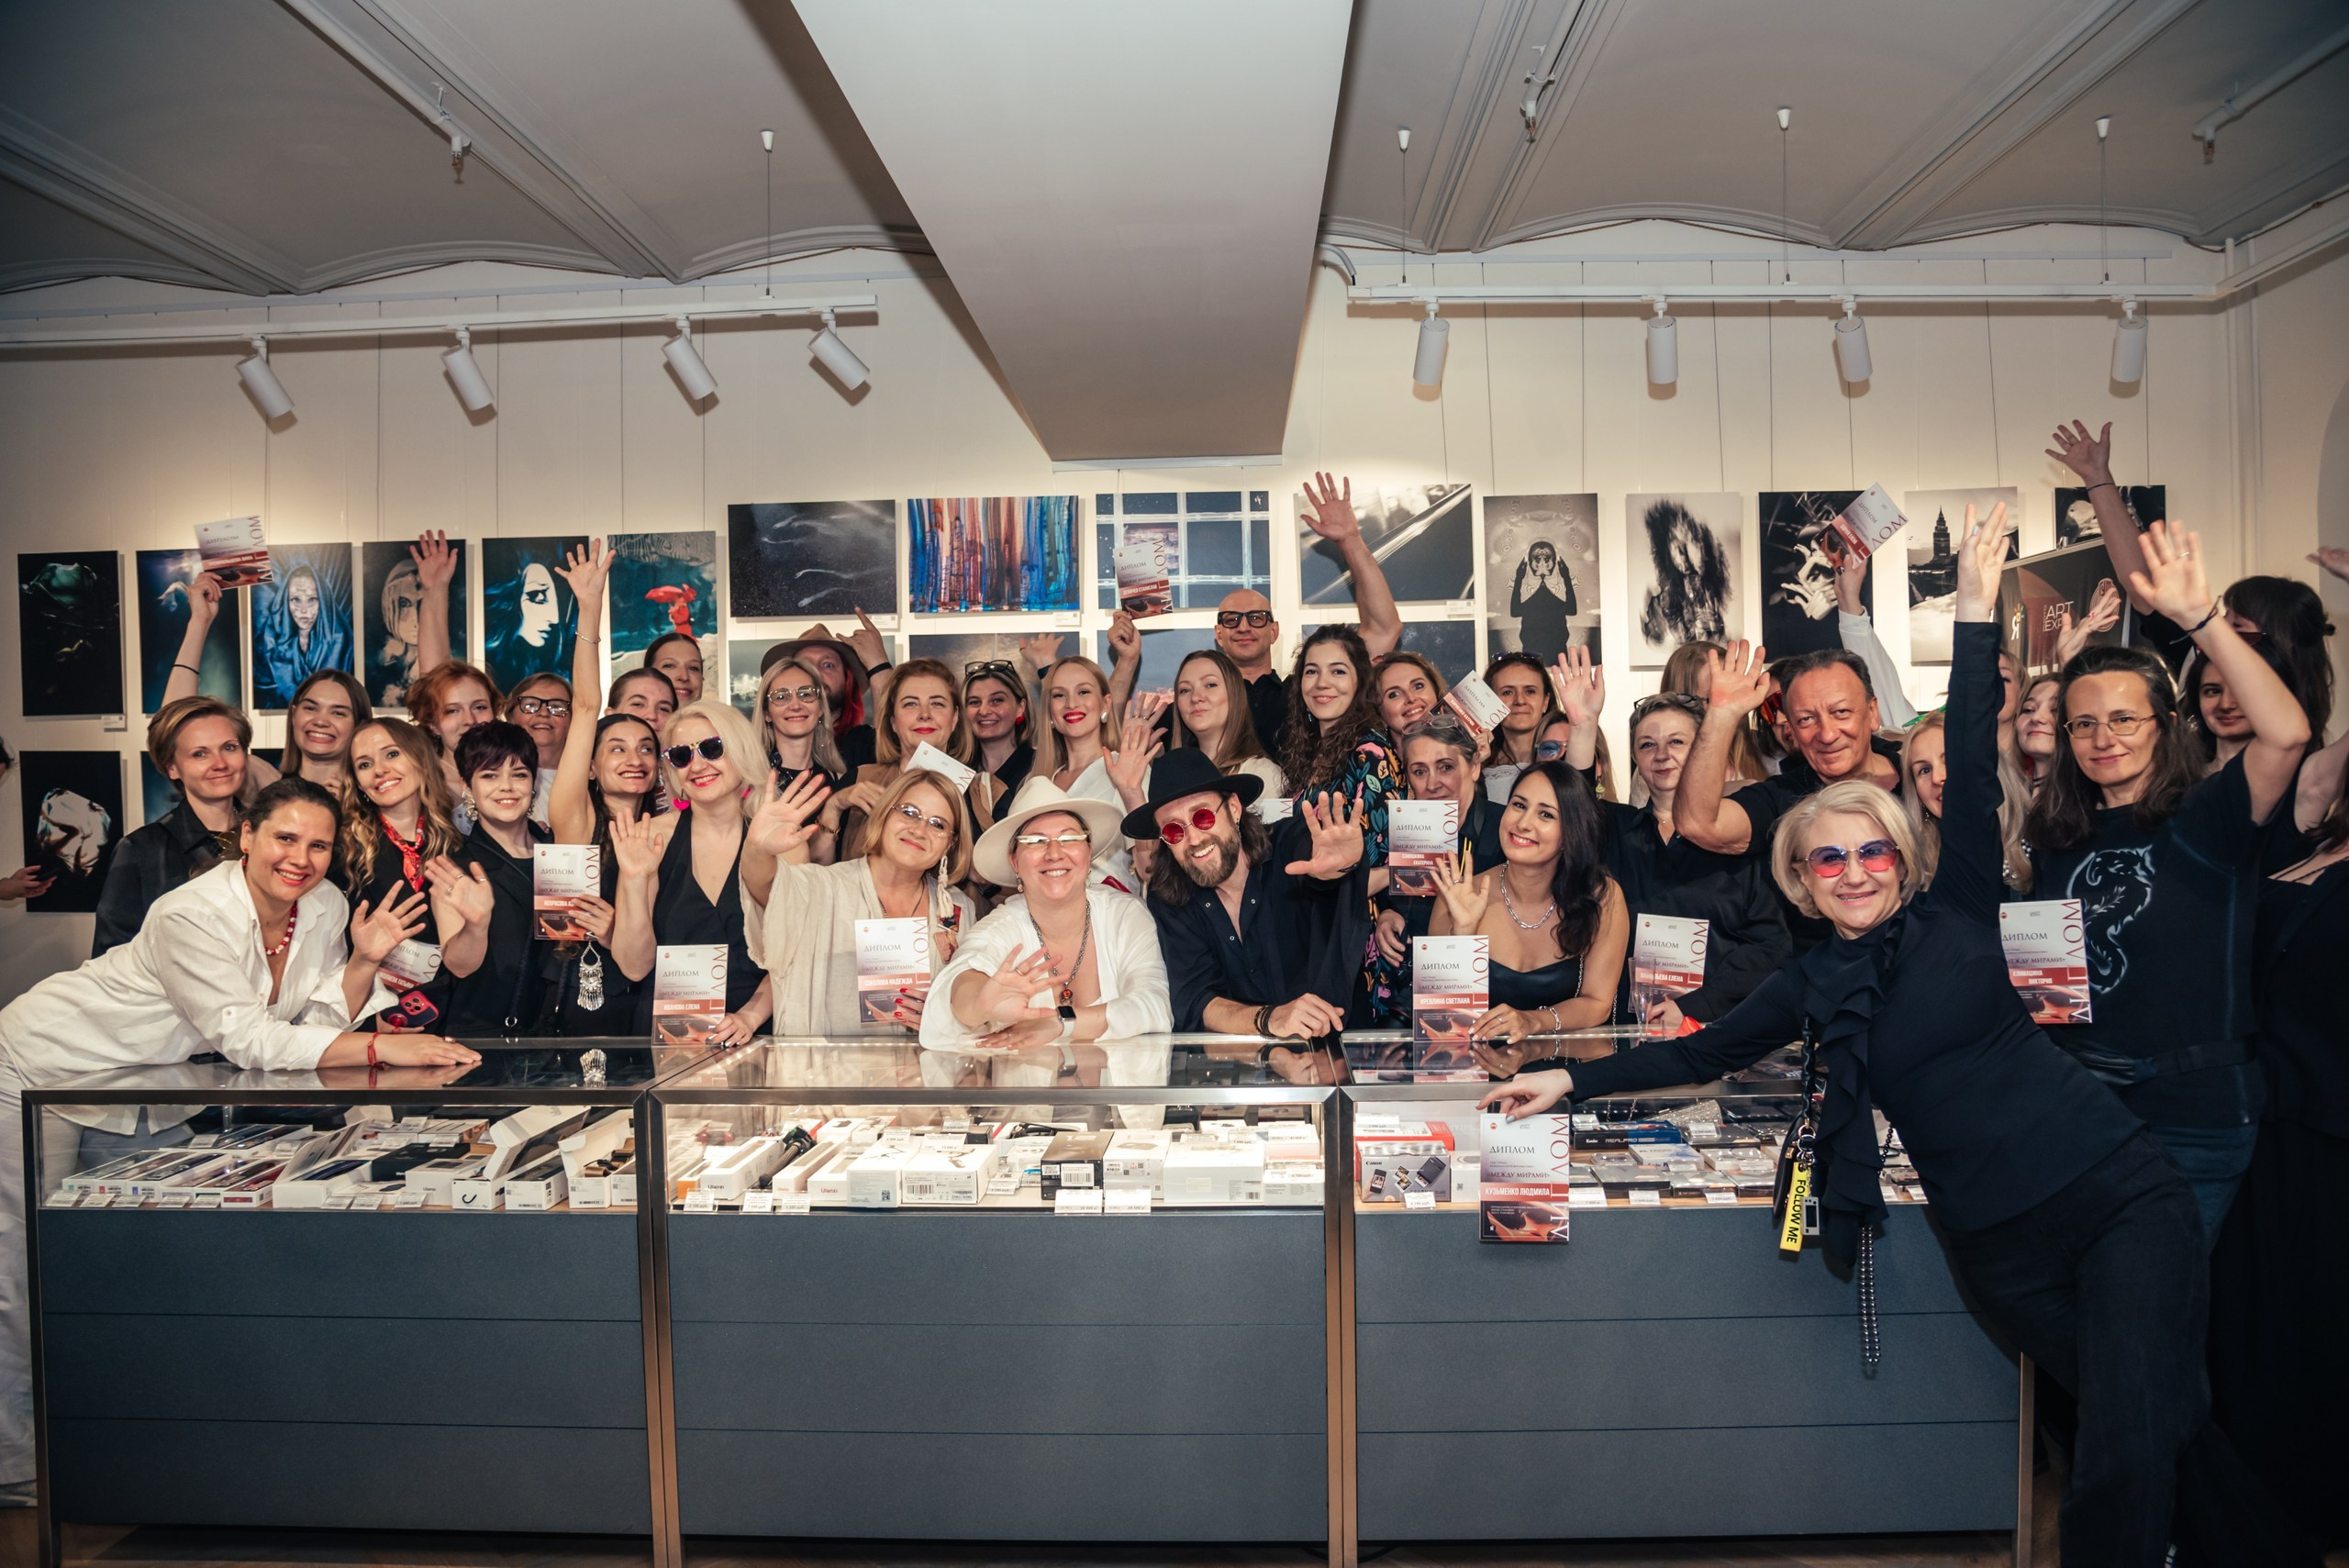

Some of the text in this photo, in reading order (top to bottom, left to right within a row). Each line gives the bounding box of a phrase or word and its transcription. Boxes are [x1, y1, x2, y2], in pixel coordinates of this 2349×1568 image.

[2044, 617, 2063, 631] EXP
[2001, 932, 2048, 941] ДИПЛОМ
[863, 944, 902, 952] ДИПЛОМ
[1642, 939, 1679, 950] ДИПЛОМ
[1420, 962, 1460, 971] ДИПЛОМ
[662, 970, 699, 978] ДИПЛОМ
[1489, 1145, 1535, 1154] ДИПЛОМ
[1485, 1186, 1551, 1197] КУЗЬМЕНКО ЛЮДМИЛА
[1786, 1179, 1807, 1244] FOLLOW ME
